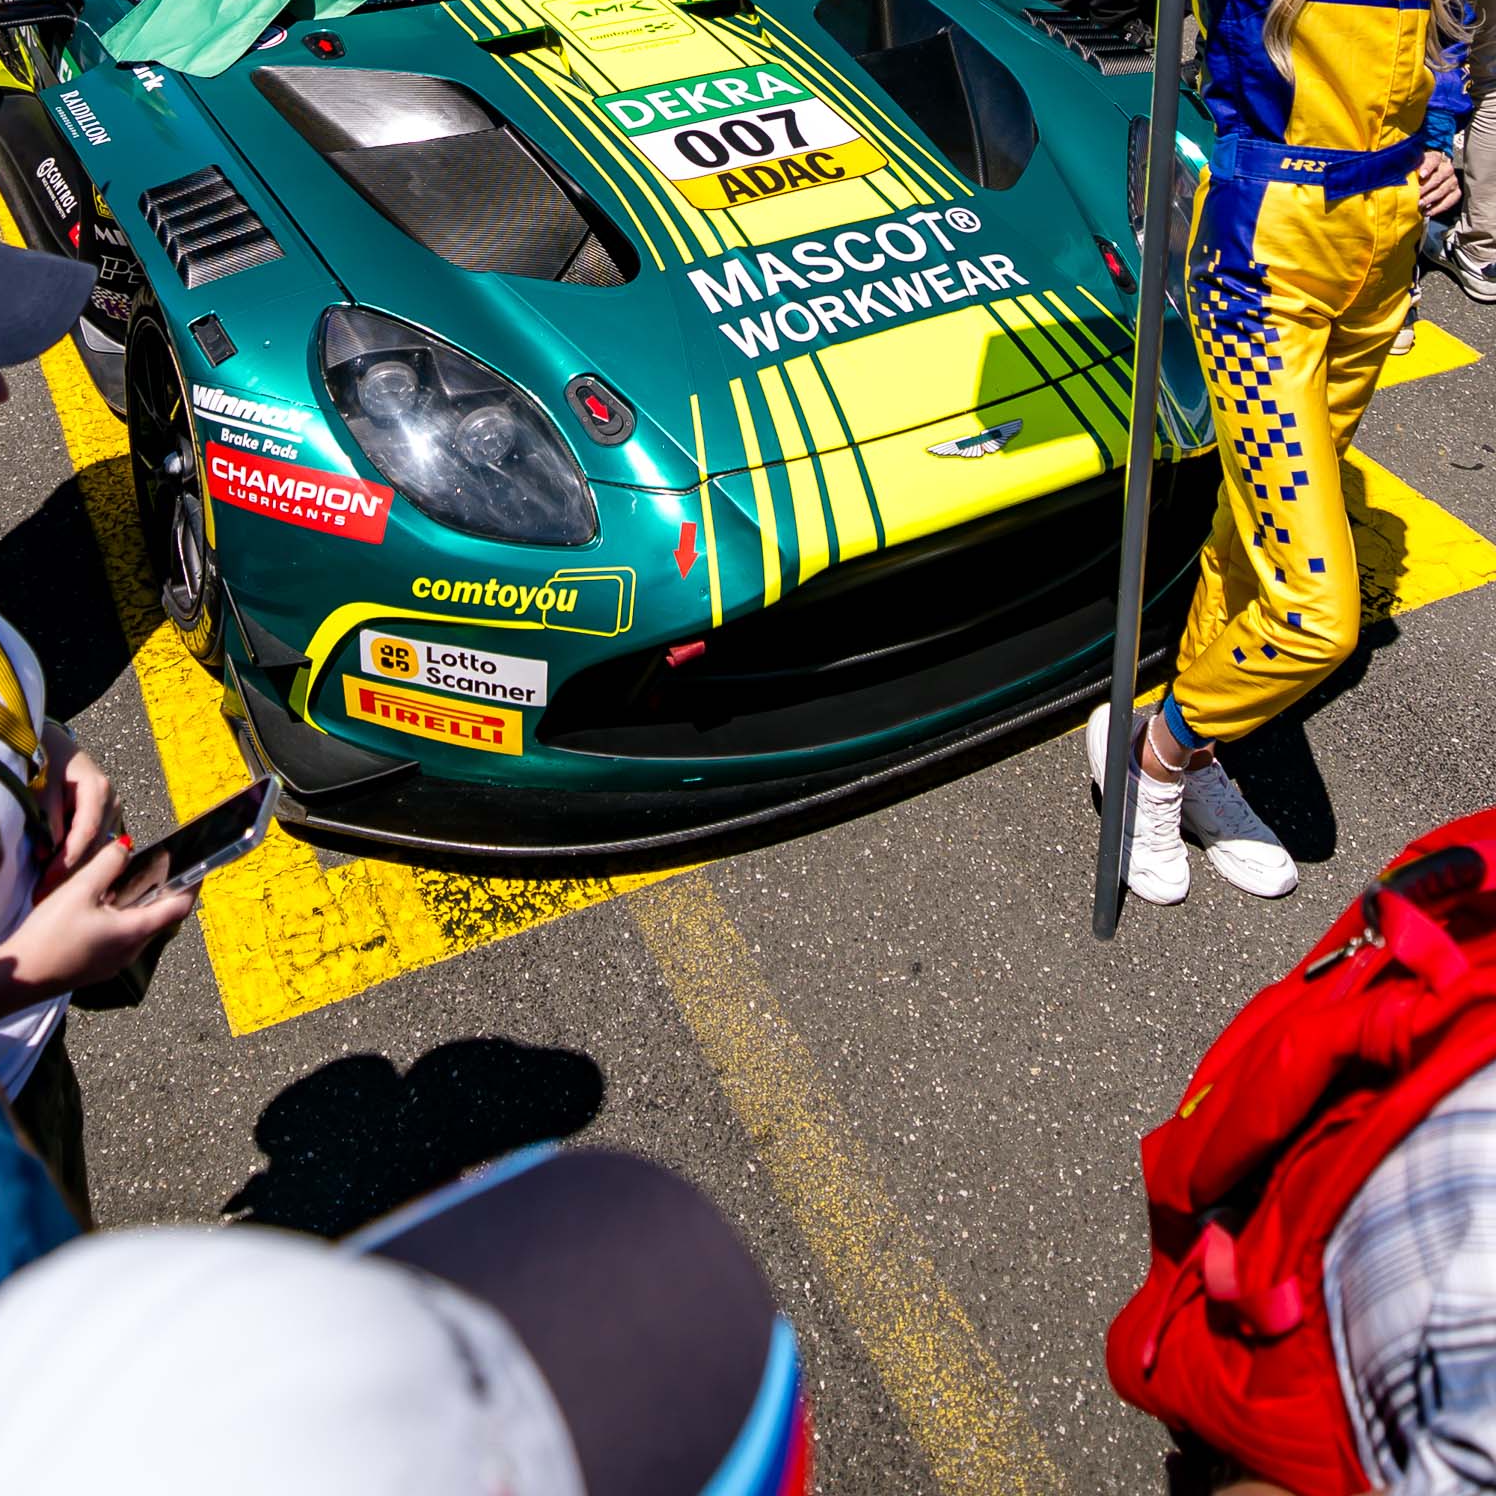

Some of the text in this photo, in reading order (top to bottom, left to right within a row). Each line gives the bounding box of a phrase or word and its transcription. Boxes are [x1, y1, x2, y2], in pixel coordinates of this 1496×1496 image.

[60, 90, 112, 145] RAIDILLON
[604, 71, 804, 131] DEKRA
[673, 111, 812, 169] 007
[716, 150, 846, 203] ADAC
[718, 253, 1030, 360] WORKWEAR
[193, 384, 311, 432] Winmax
[221, 428, 298, 460] Brake Pads
[211, 457, 380, 517] CHAMPION
[228, 486, 346, 526] LUBRICANTS
[411, 576, 578, 616] comtoyou
[425, 645, 497, 675] Lotto
[425, 665, 536, 703] Scanner
[358, 688, 505, 745] PIRELLI
